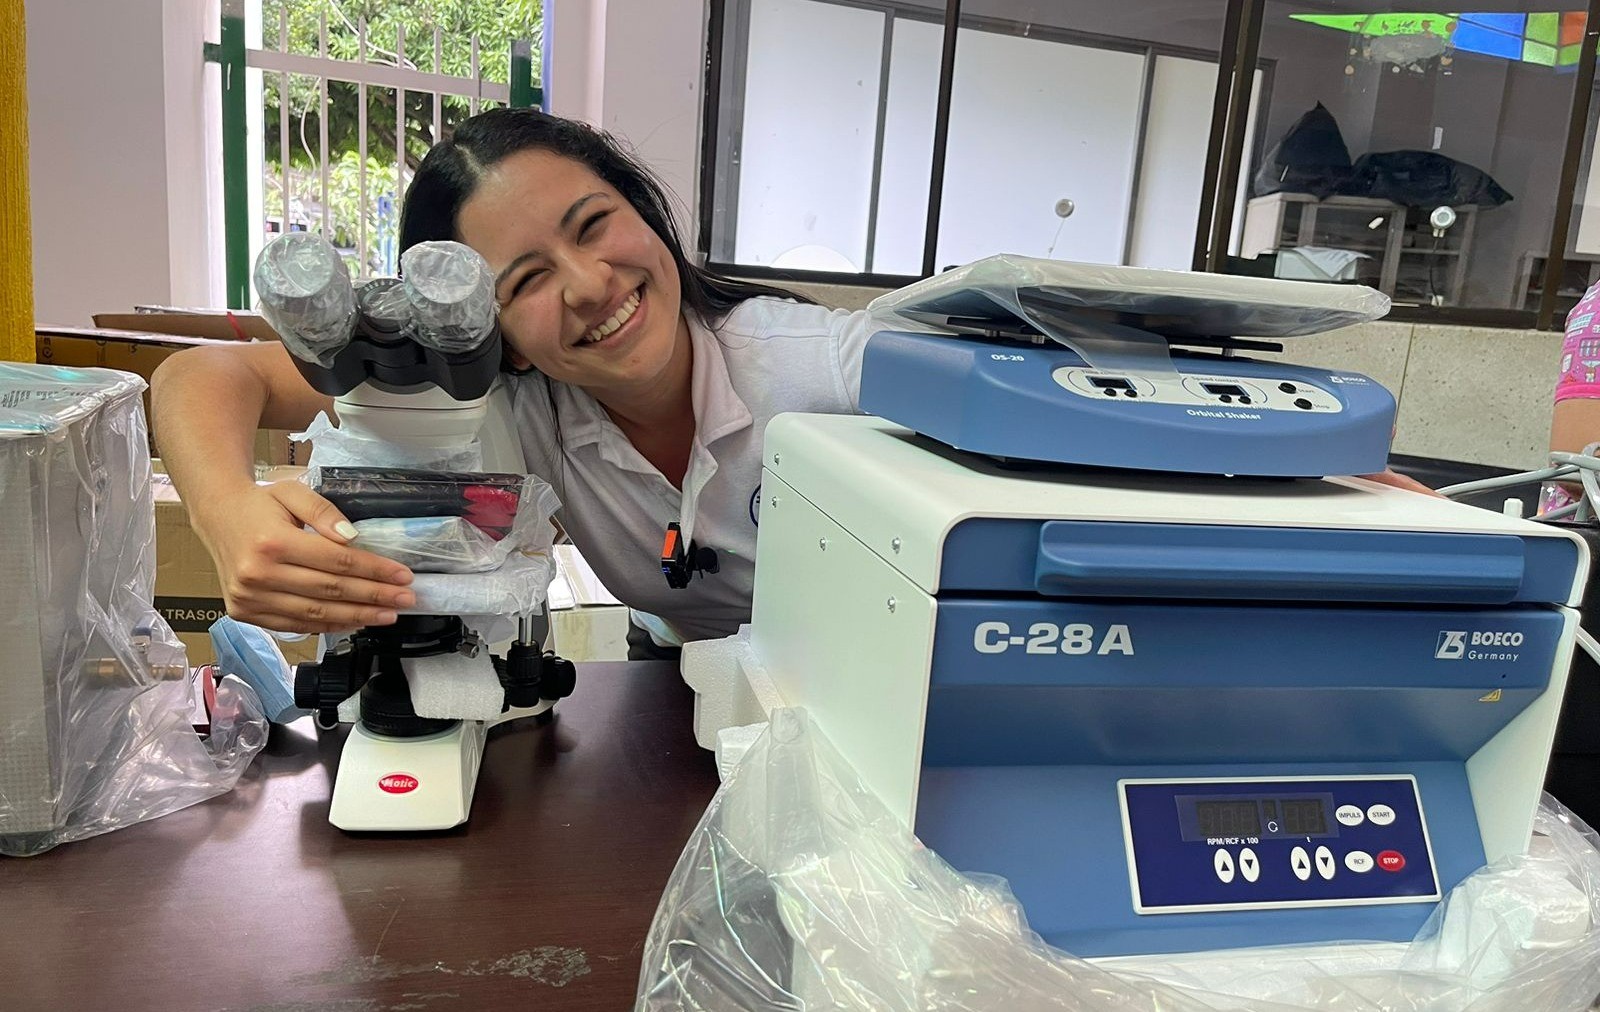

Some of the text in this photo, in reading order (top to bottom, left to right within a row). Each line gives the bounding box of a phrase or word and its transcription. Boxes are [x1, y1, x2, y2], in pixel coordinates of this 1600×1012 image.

[1186, 408, 1262, 421] Orbital Shaker
[1470, 631, 1524, 646] BOECO
[1468, 650, 1519, 661] Germany
[381, 778, 415, 788] Motic
[1207, 837, 1239, 845] RPM/RCF
[1383, 857, 1399, 865] STOP
